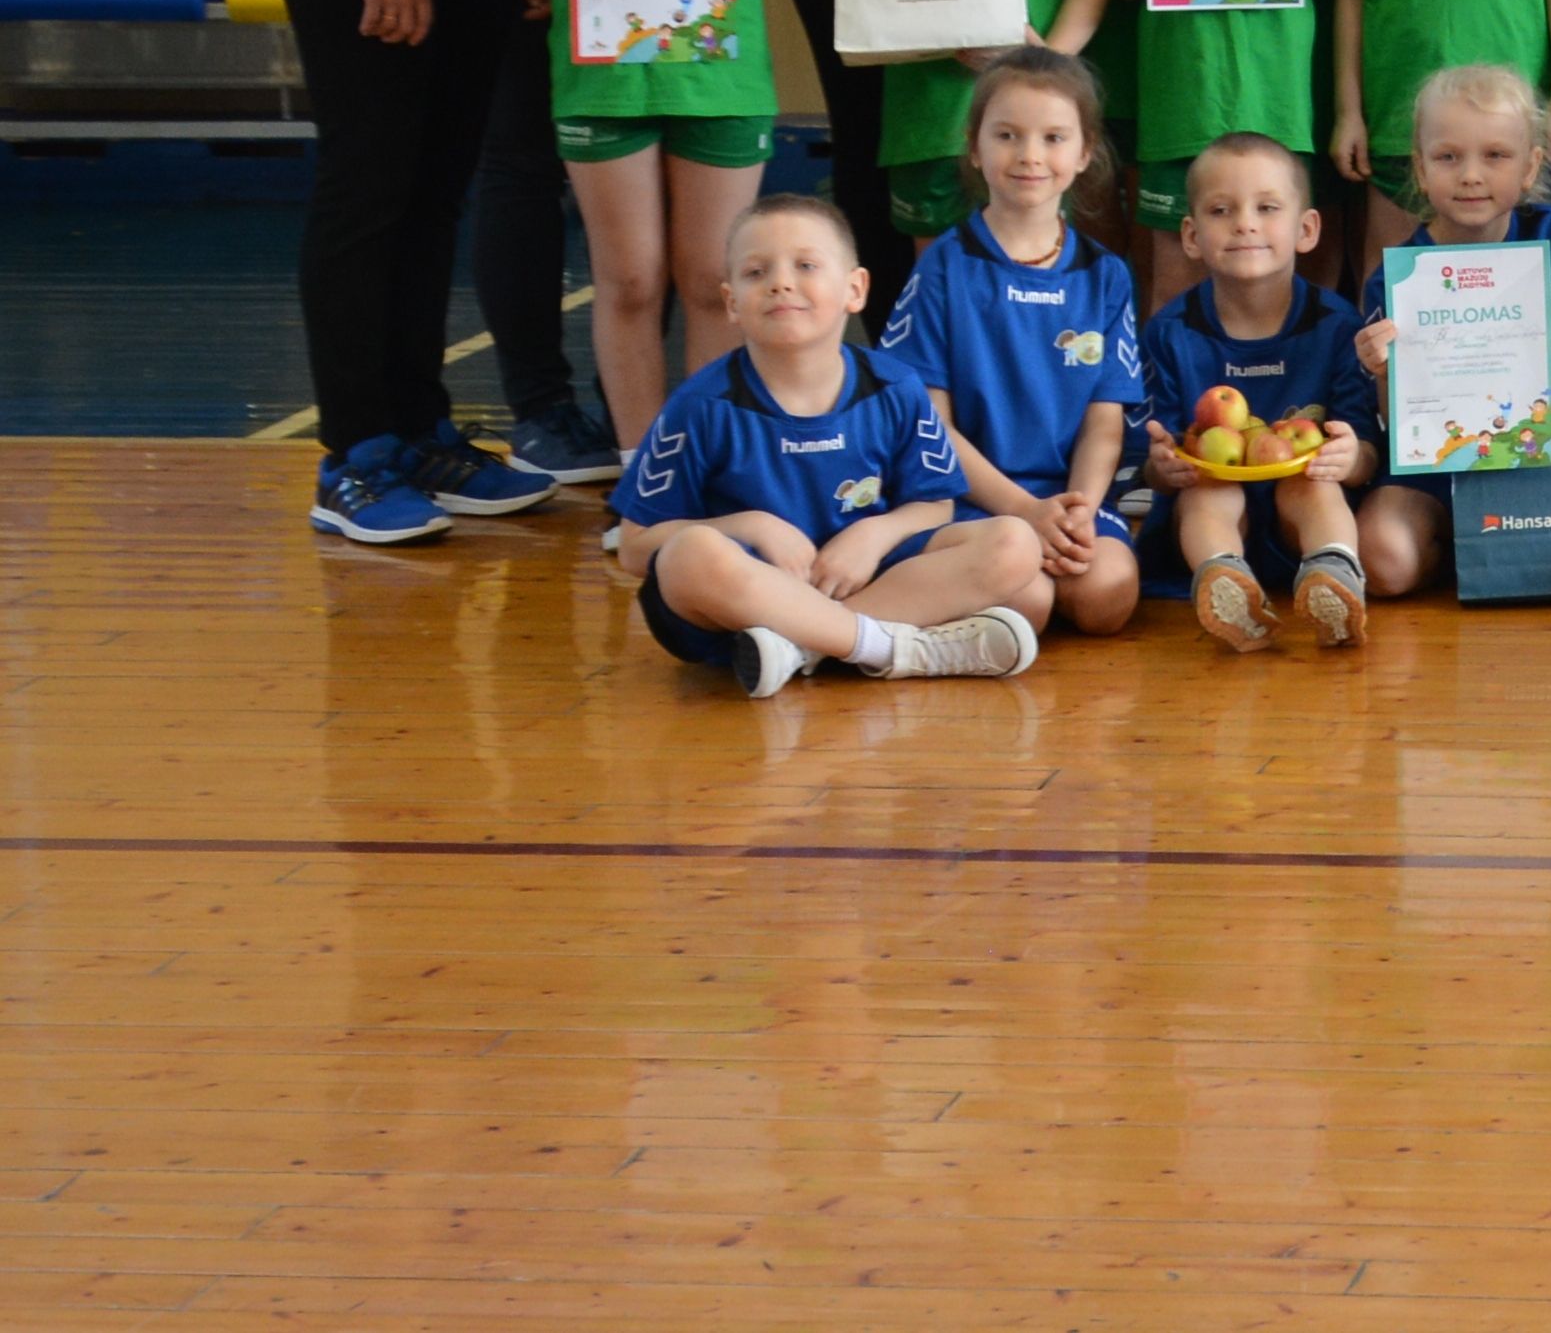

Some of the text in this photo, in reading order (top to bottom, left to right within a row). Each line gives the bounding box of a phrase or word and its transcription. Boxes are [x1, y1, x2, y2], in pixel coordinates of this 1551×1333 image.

[1007, 284, 1066, 305] hummel
[1417, 305, 1522, 327] DIPLOMAS
[1225, 360, 1284, 377] hummel
[781, 433, 846, 454] hummel
